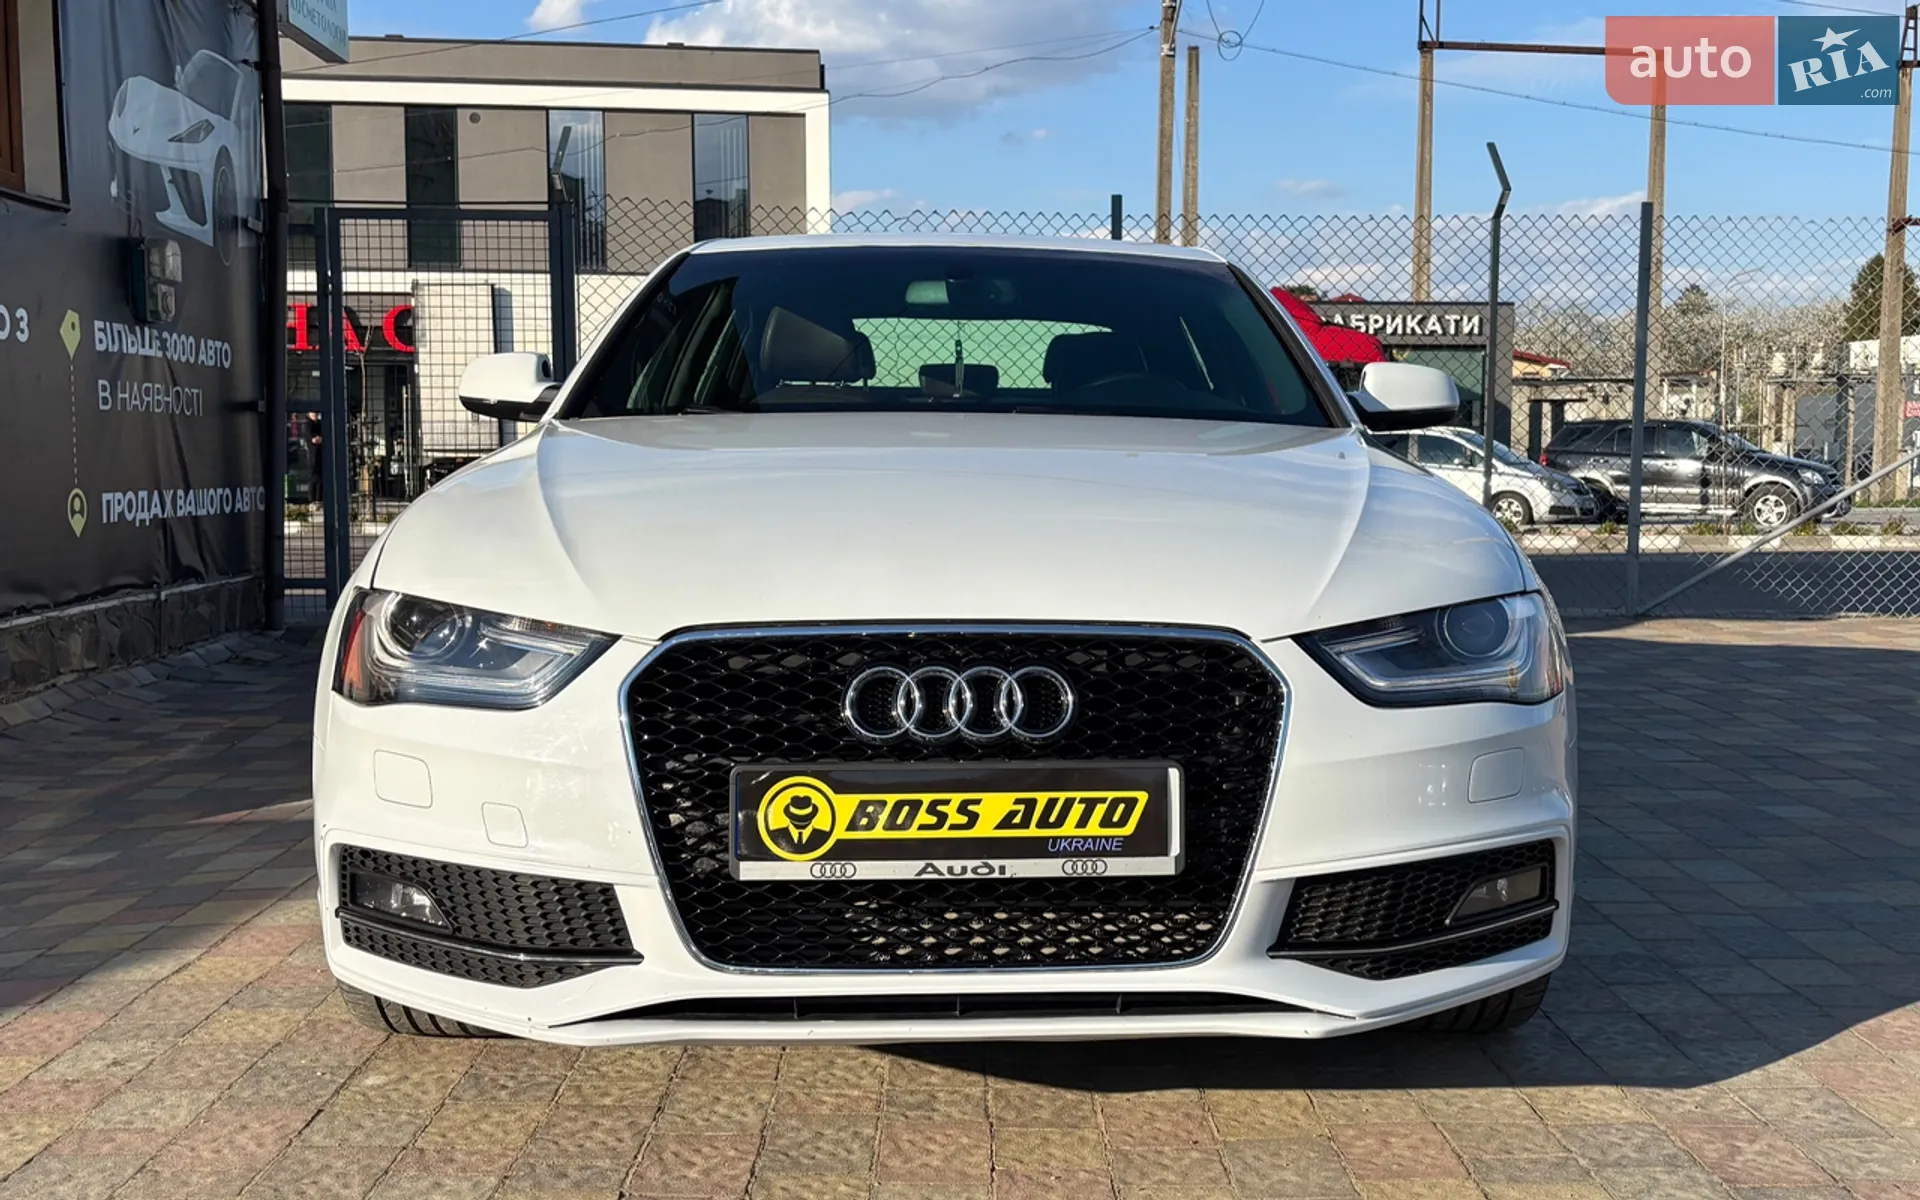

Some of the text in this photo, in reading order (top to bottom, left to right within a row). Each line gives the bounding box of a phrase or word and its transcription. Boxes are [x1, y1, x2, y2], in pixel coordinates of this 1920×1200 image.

[1321, 313, 1481, 335] БРИКАТИ
[94, 320, 231, 369] БІЛЬШЕ 3000 АВТО
[98, 379, 203, 417] В НАЯВНОСТІ
[102, 489, 175, 527] ПРОДАЖ
[176, 487, 232, 517] ВАШОГО
[844, 796, 1142, 832] BOSS AUTO
[1048, 838, 1124, 852] UKRAINE
[914, 861, 1008, 877] Audi
